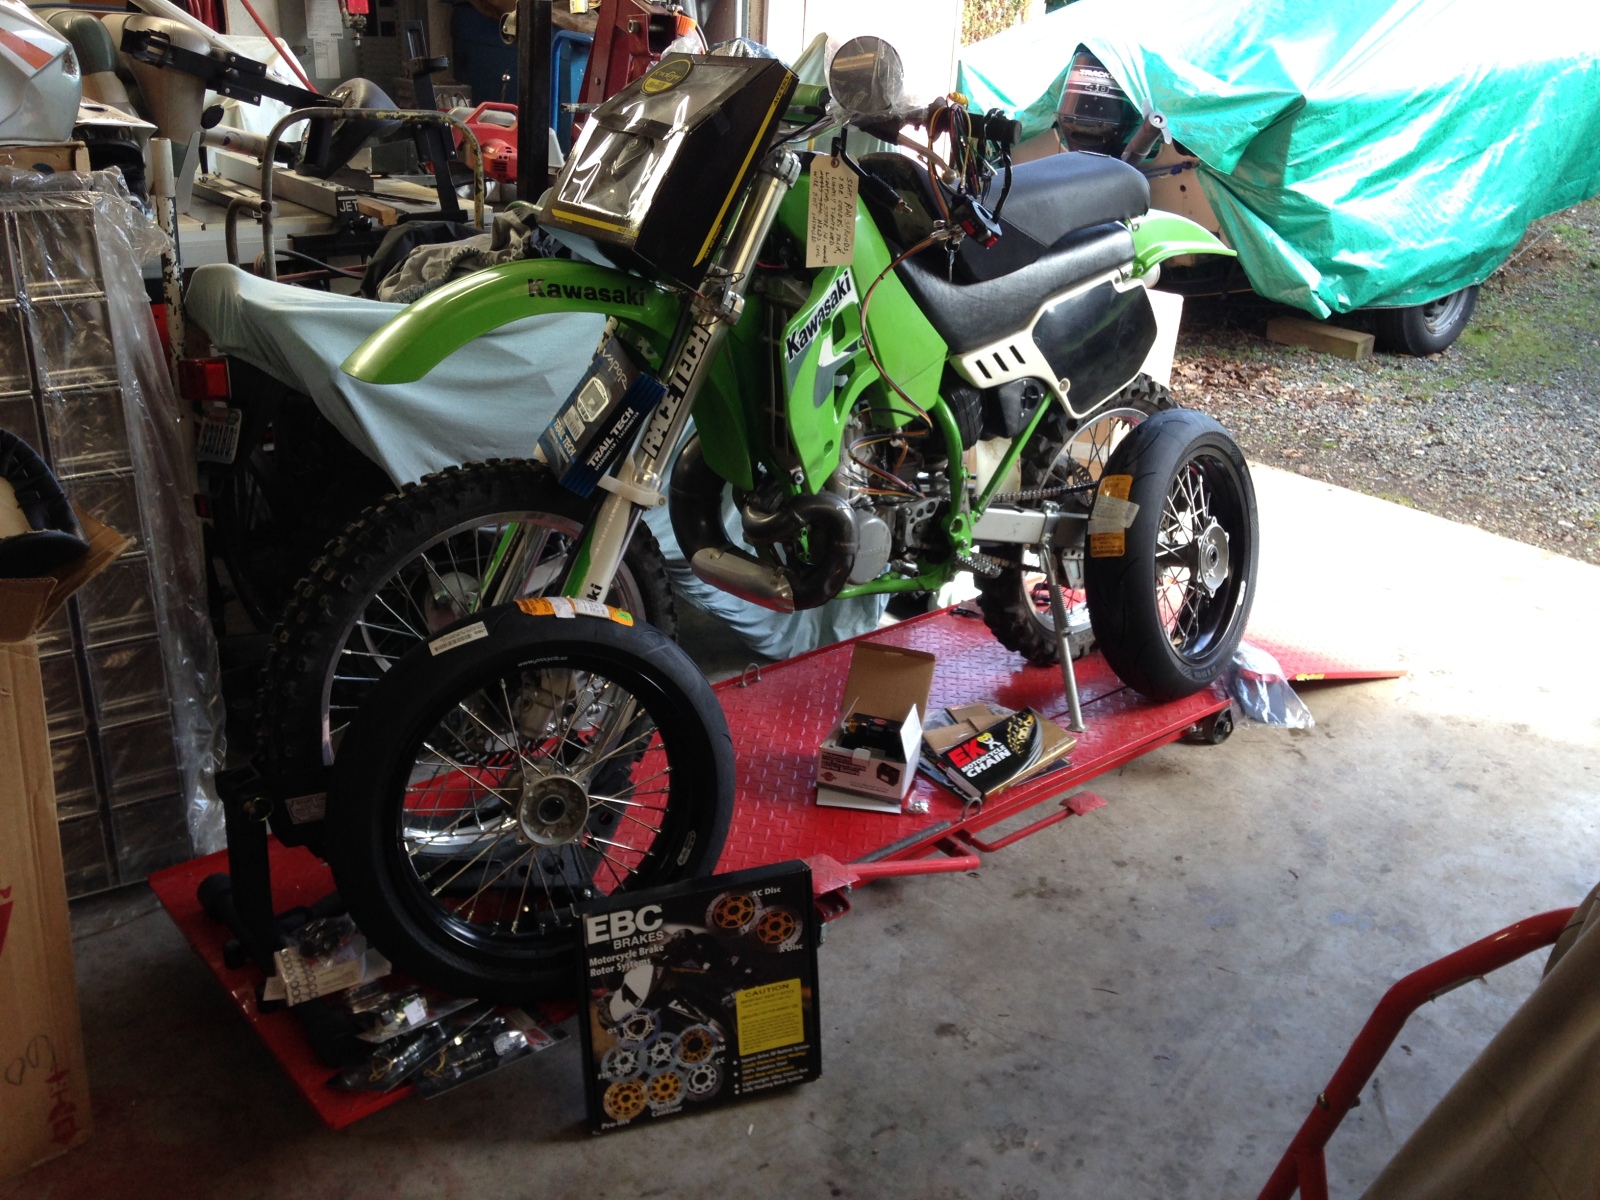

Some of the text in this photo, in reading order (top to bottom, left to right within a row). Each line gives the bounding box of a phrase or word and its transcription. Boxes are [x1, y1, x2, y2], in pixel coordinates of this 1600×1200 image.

[339, 200, 359, 213] JET
[528, 278, 645, 307] Kawasaki
[785, 269, 852, 362] Kawasaki
[640, 324, 711, 460] RACE TECH
[586, 437, 615, 467] TRAIL
[610, 406, 635, 436] TECH
[947, 737, 987, 769] EK
[961, 745, 1008, 774] MOTORCYCLE
[966, 748, 1012, 778] CHAIN
[586, 904, 663, 946] EBC
[613, 930, 665, 950] BRAKES
[589, 943, 665, 967] Motorcycle Brake
[590, 957, 652, 978] Rotor Systems
[745, 983, 790, 998] CAUTION
